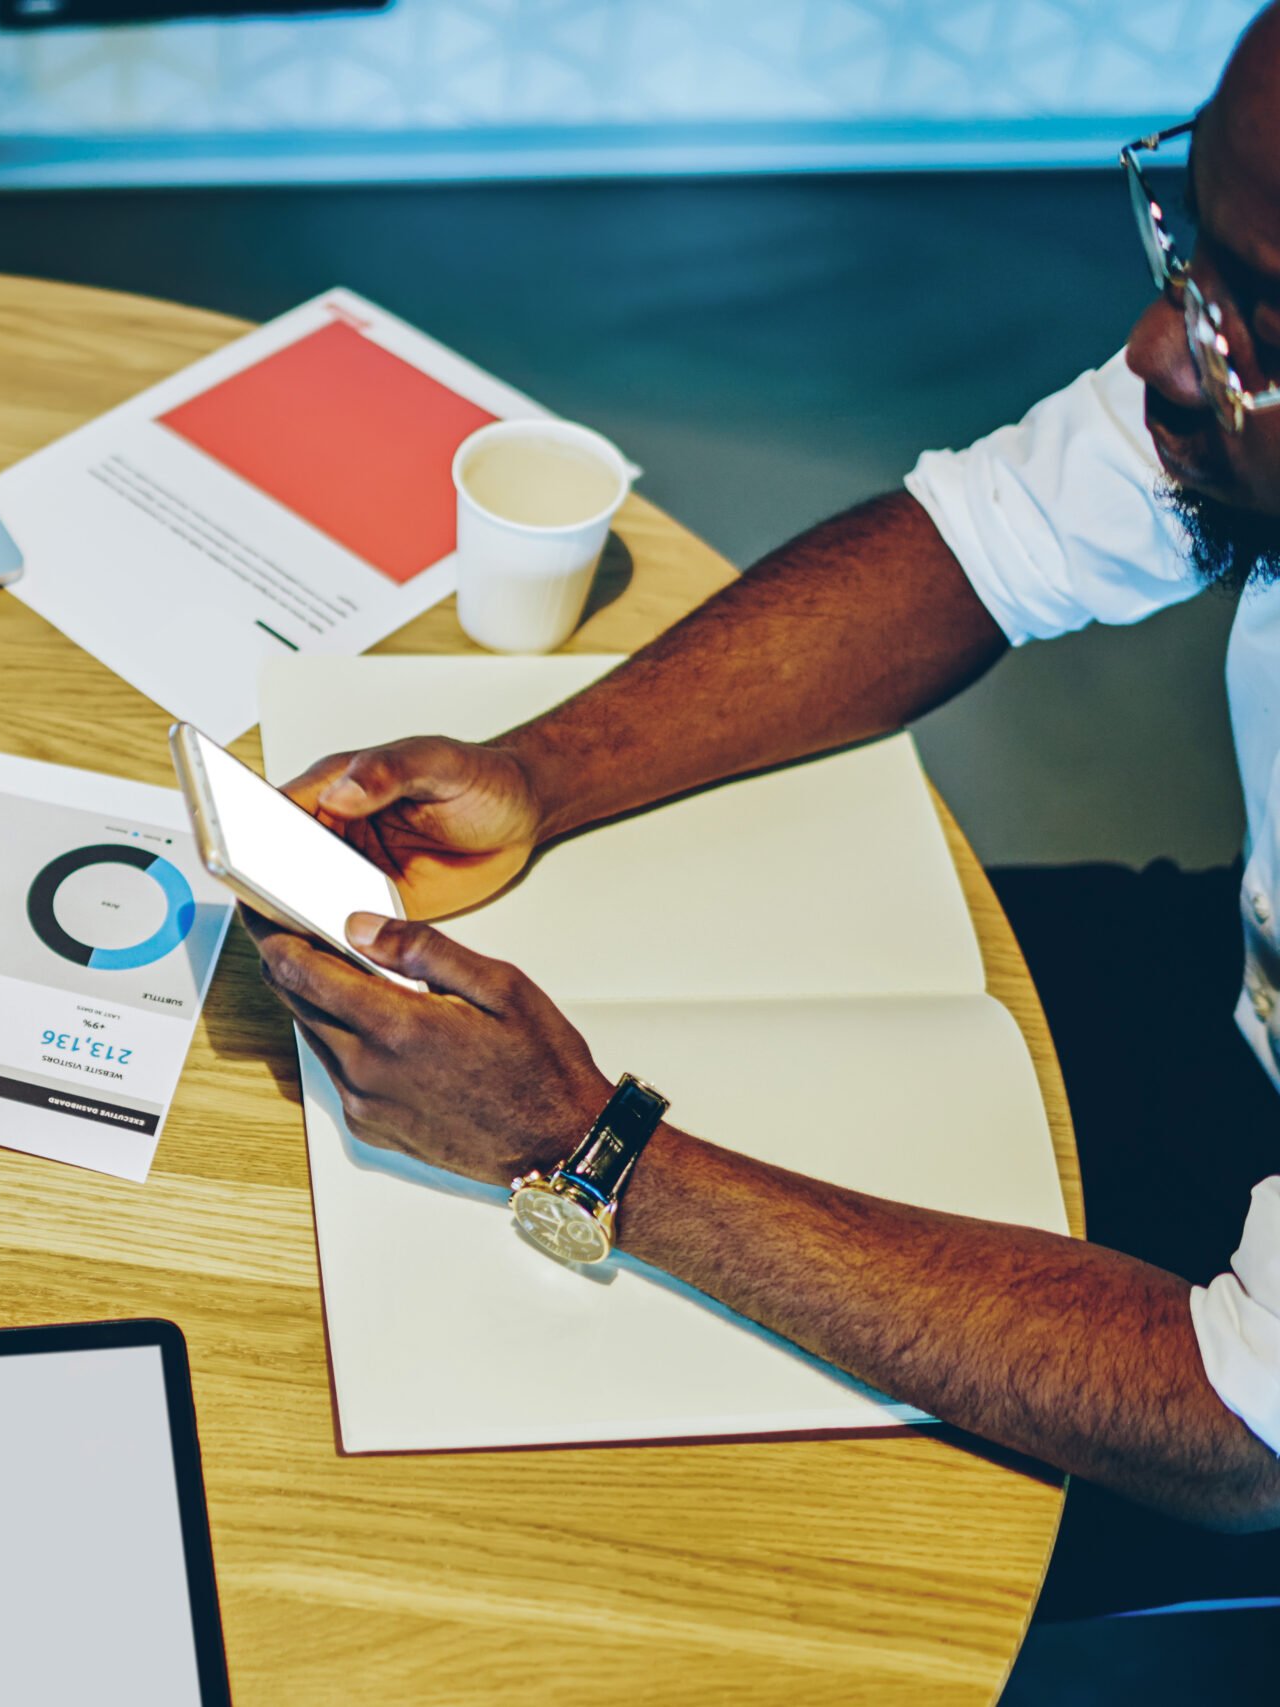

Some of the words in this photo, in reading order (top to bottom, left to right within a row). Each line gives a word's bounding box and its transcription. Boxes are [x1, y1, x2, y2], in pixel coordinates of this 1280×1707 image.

[142, 992, 184, 1008] SUBTITLE
[82, 1018, 106, 1031] +9%
[40, 1030, 134, 1066] 213,136
[41, 1055, 84, 1072] VISITORS
[84, 1065, 124, 1081] WEBSITE
[48, 1096, 99, 1115] DASHBOARD
[98, 1109, 146, 1127] EXECUTIVE
